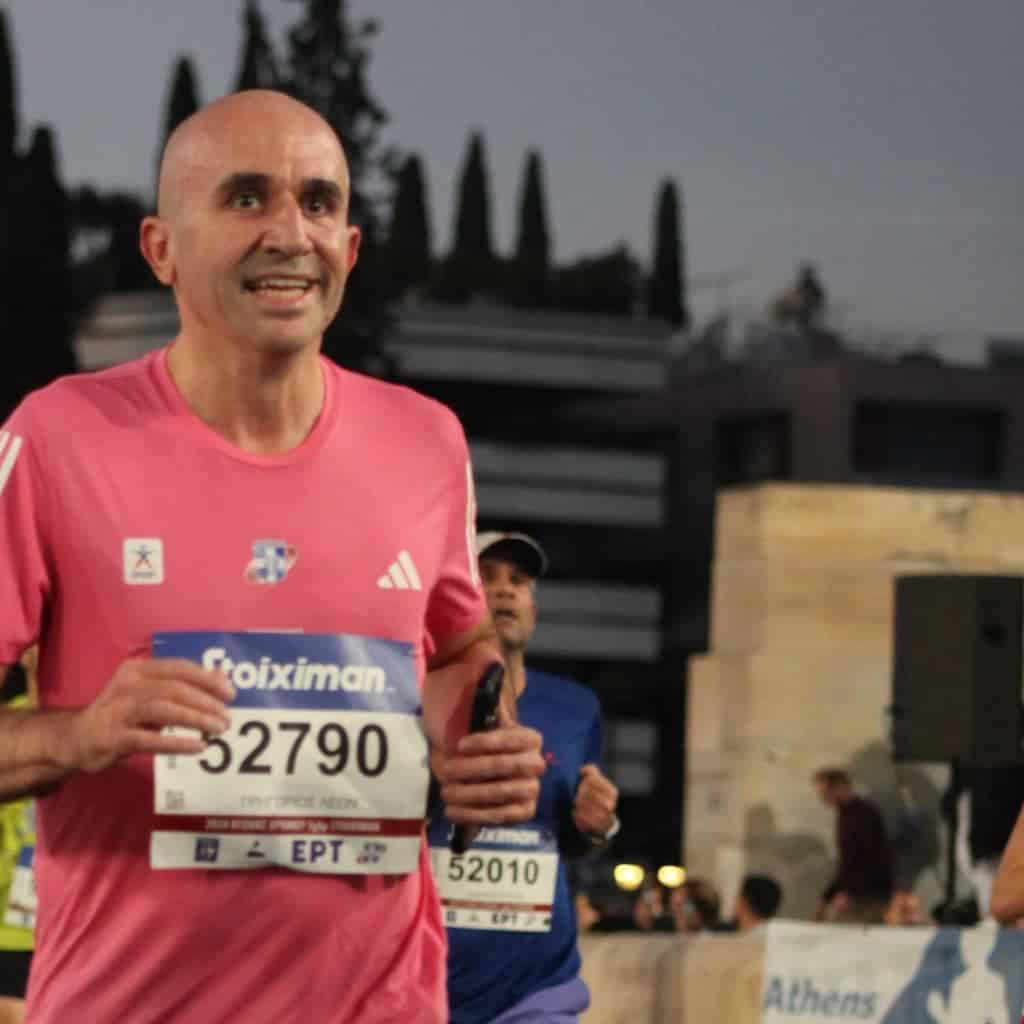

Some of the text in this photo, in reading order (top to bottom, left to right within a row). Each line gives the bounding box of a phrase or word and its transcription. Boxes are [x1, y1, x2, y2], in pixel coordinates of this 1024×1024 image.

[198, 721, 388, 777] 52790
[448, 856, 540, 885] 52010
[763, 976, 876, 1018] Athens
